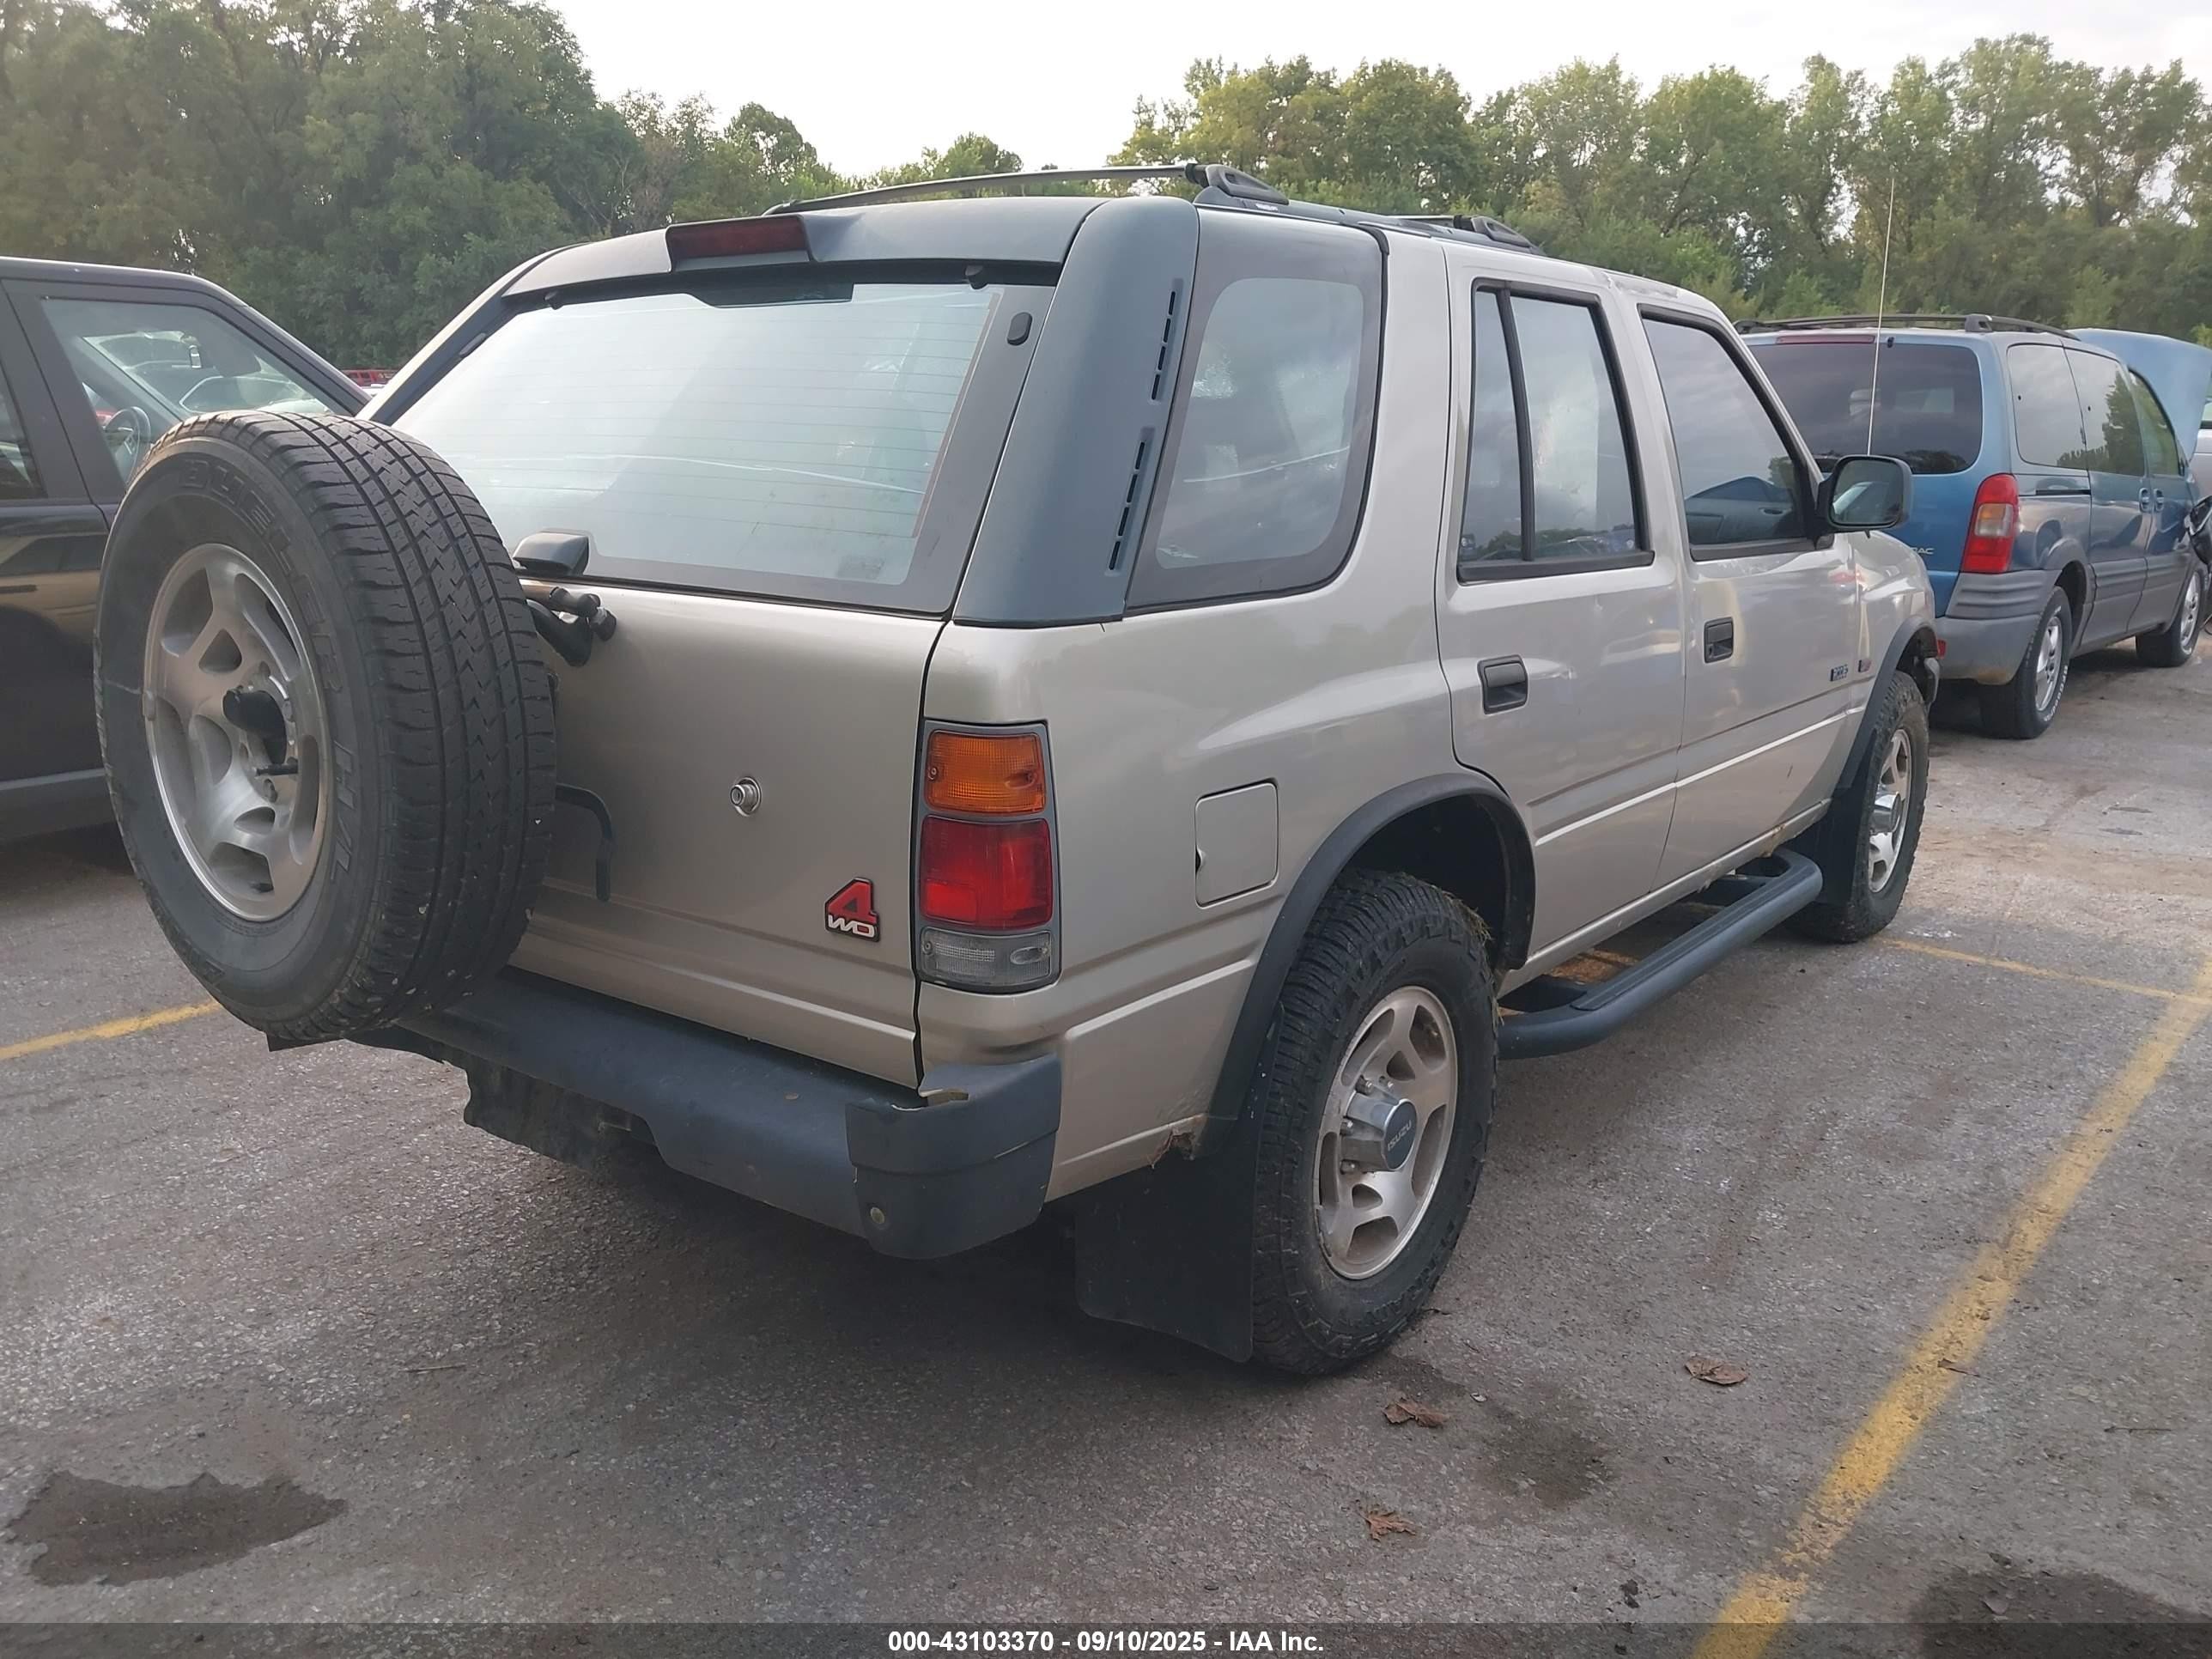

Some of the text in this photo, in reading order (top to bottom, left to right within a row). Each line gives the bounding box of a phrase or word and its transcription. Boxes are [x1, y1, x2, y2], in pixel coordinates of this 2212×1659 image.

[826, 875, 878, 926] 4
[827, 914, 875, 938] WD
[1387, 1120, 1413, 1152] ISUZU
